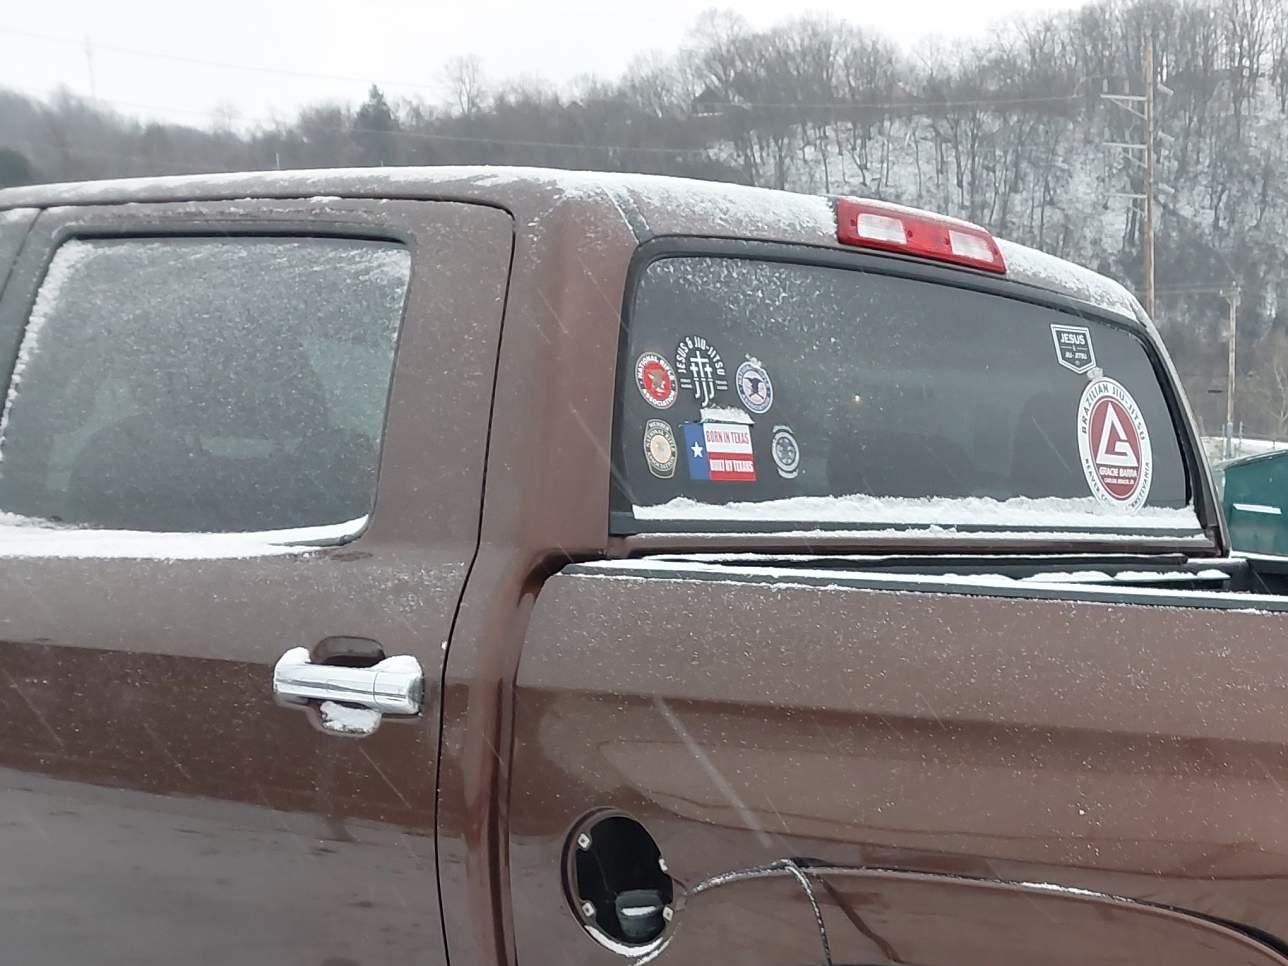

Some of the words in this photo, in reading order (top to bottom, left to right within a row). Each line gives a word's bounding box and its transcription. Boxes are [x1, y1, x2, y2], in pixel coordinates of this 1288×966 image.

[1060, 333, 1085, 345] JESUS
[676, 342, 689, 374] JESUS
[694, 336, 726, 376] JIU-JITSU
[1081, 383, 1109, 434] BRAZILIAN
[1112, 386, 1145, 440] JIU-JITSU
[705, 430, 723, 443] BORN
[723, 431, 731, 444] IN
[730, 431, 749, 444] TEXAS
